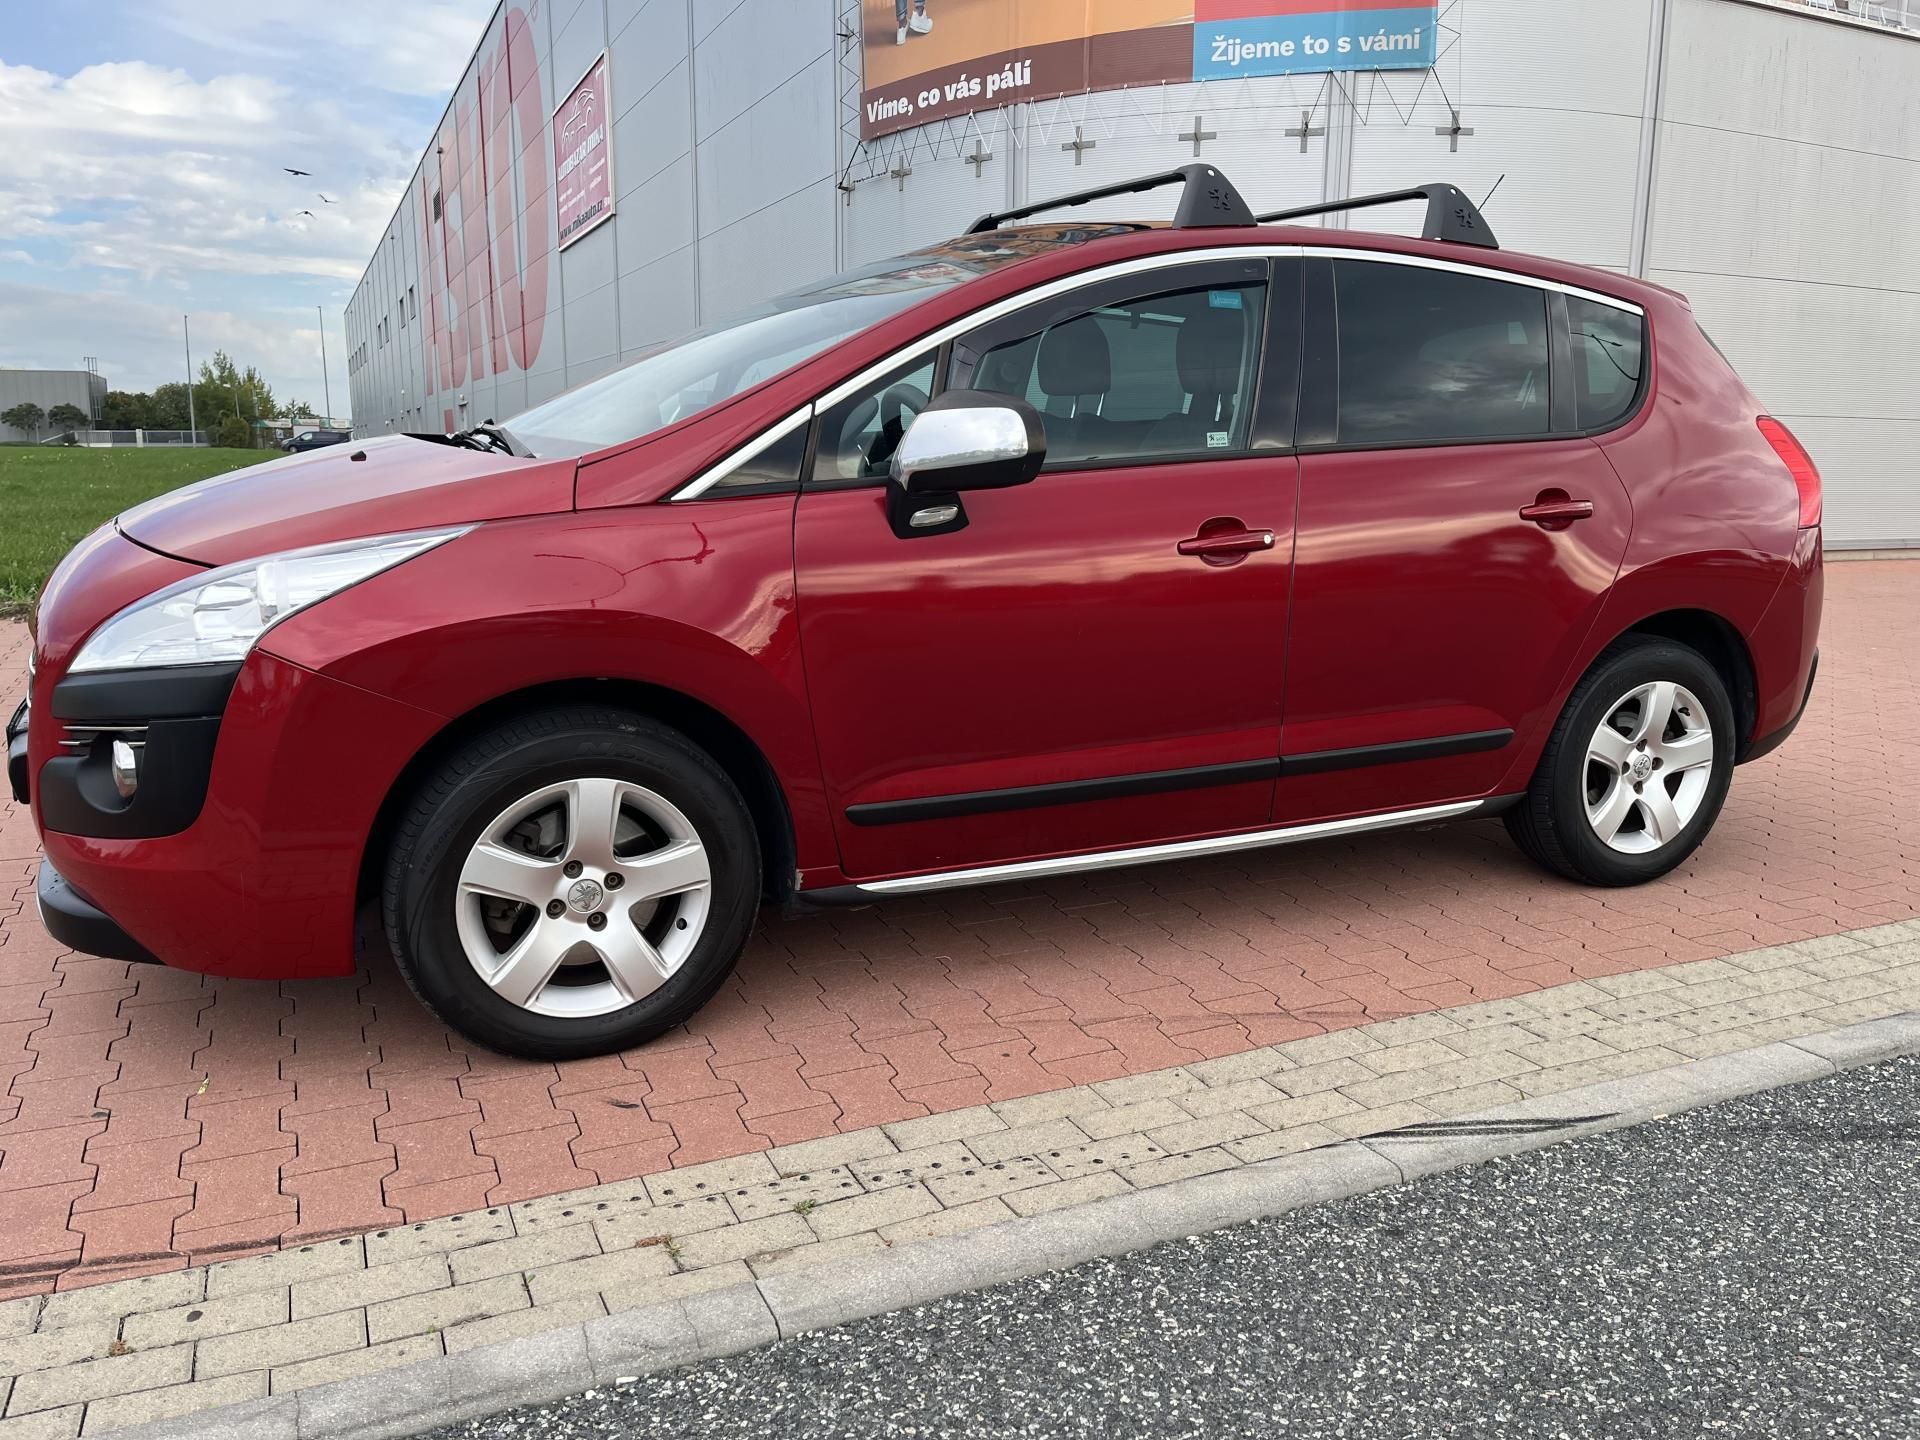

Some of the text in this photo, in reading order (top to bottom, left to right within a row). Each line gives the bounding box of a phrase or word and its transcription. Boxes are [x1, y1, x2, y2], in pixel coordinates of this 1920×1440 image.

[1211, 28, 1421, 66] Žijeme to s vámi
[866, 59, 1032, 124] Víme, co vás pálí
